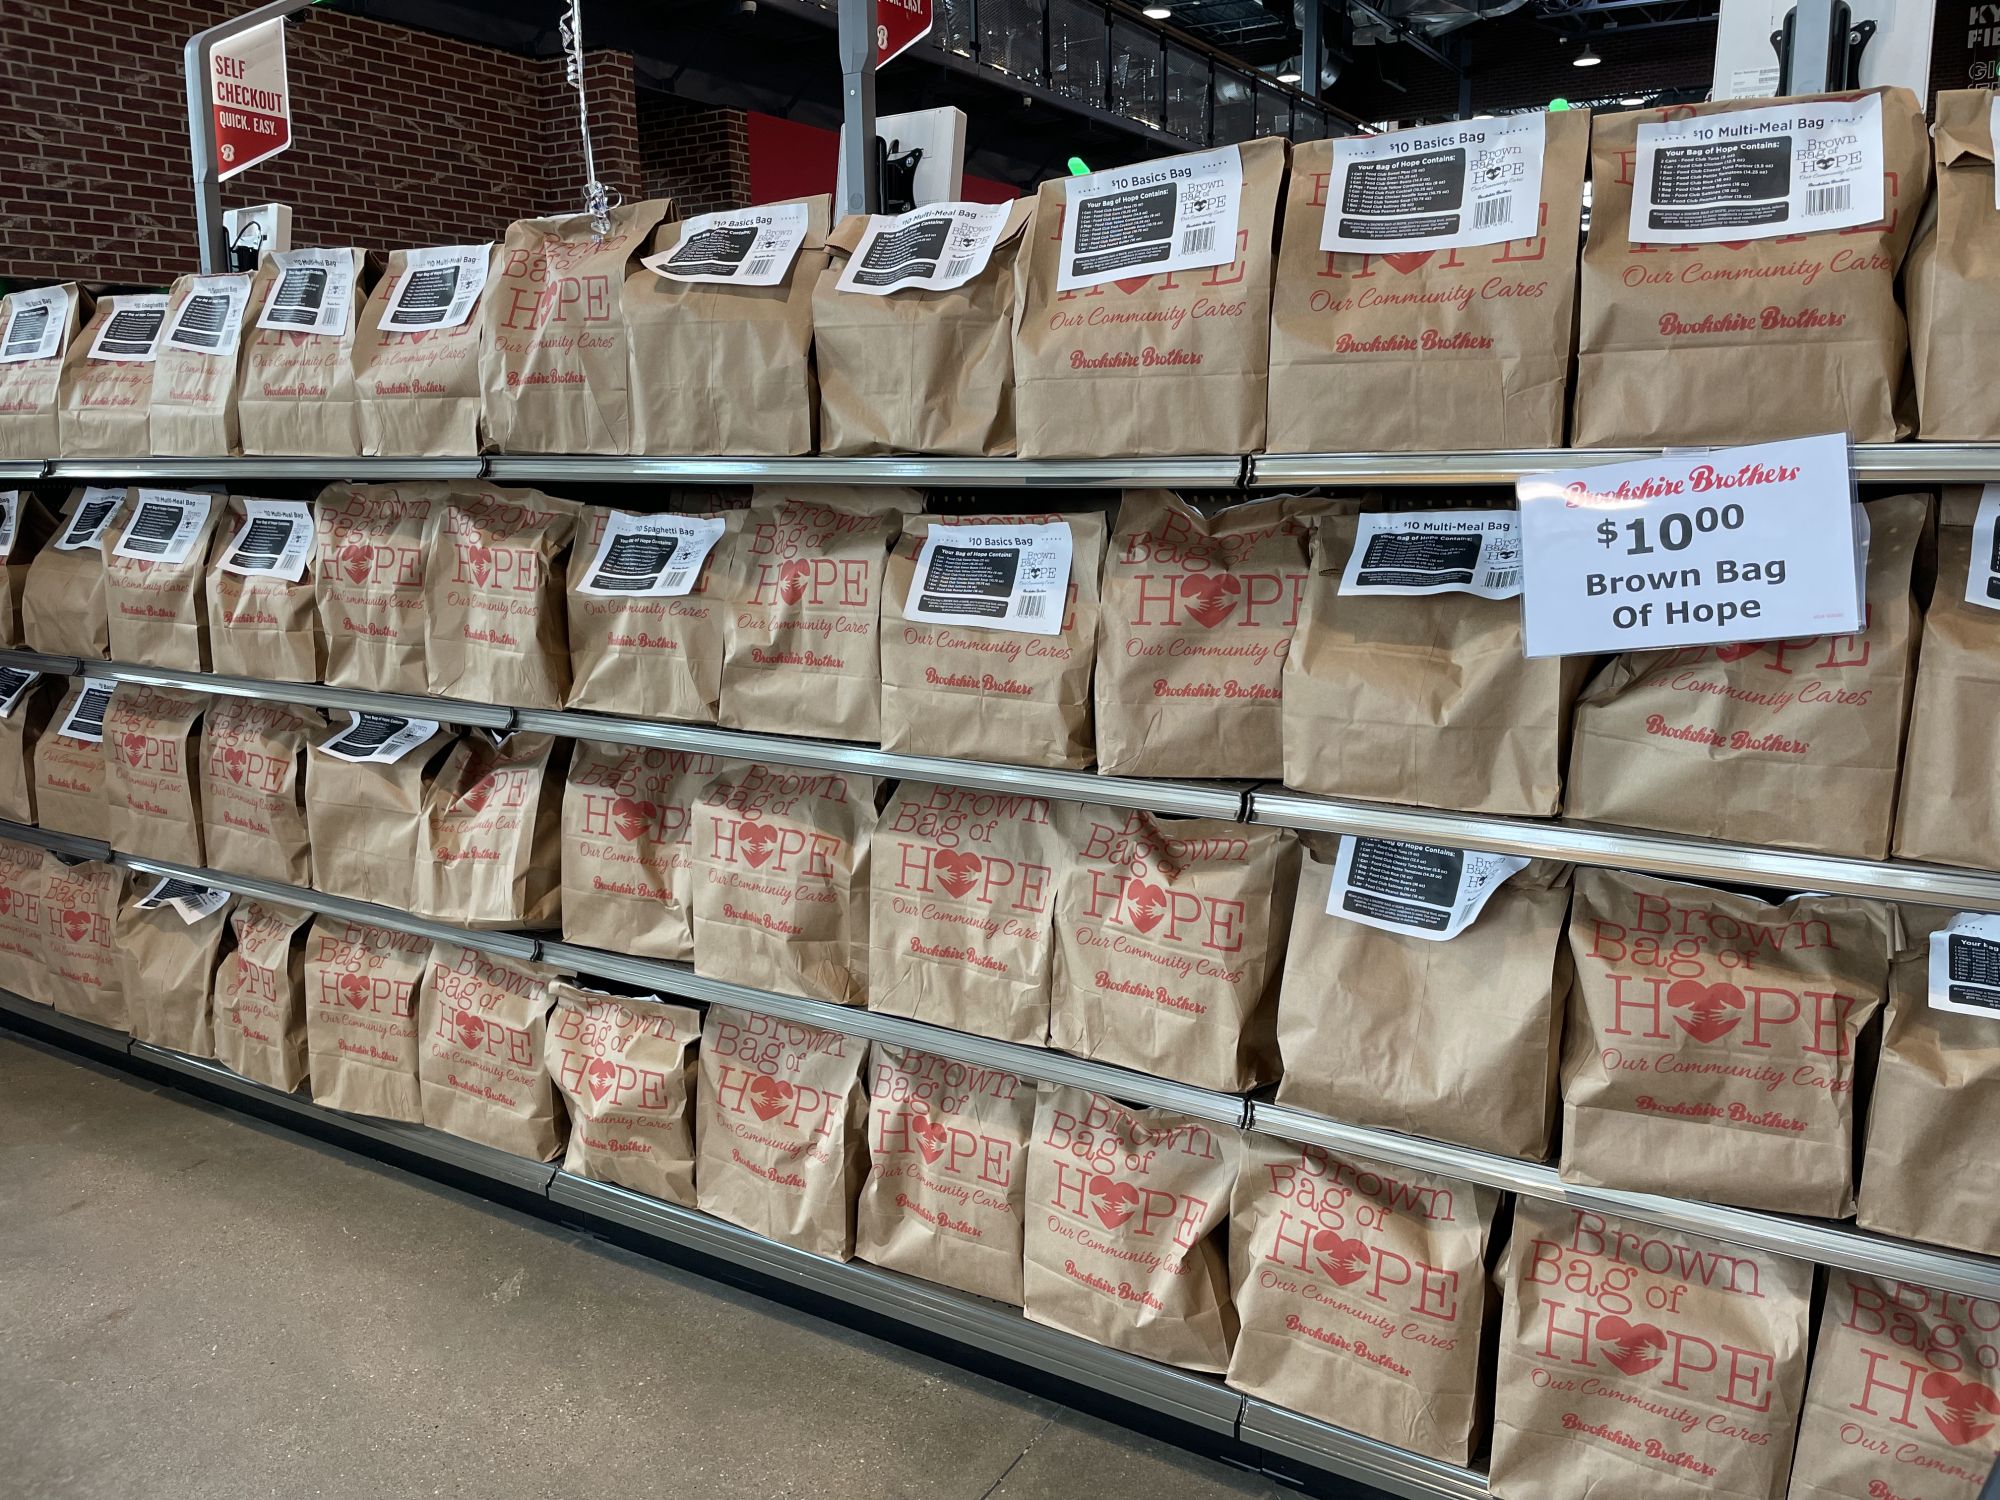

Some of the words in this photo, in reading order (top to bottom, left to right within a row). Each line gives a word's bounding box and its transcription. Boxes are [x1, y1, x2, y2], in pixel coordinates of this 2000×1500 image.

[215, 55, 245, 79] SELF
[217, 82, 282, 112] CHECKOUT
[220, 111, 250, 130] QUICK.
[254, 118, 277, 135] EASY.
[1694, 129, 1714, 141] $10
[1718, 119, 1792, 138] Multi-Meal
[1798, 118, 1824, 131] Bag
[1390, 142, 1409, 154] $10
[1414, 136, 1454, 151] Basics
[1459, 132, 1485, 143] Bag
[1479, 146, 1521, 160] Brown
[1666, 149, 1684, 157] Your
[1686, 147, 1702, 157] Bag
[1704, 146, 1714, 154] of
[1716, 143, 1739, 155] Hope
[1740, 141, 1780, 151] Contains:
[1112, 179, 1128, 190] $10
[1132, 173, 1166, 187] Basics
[1170, 167, 1192, 178] Bag
[1376, 162, 1390, 170] Bag
[1401, 158, 1420, 169] Hope
[1422, 154, 1456, 165] Contains:
[912, 209, 957, 223] Multi-Meal
[959, 209, 977, 219] Bag
[1102, 199, 1114, 207] Bag
[1122, 194, 1139, 204] Hope
[1140, 189, 1169, 200] Contains:
[729, 219, 754, 228] Basics
[755, 216, 772, 226] Bag
[1623, 264, 1674, 287] Our
[1681, 257, 1824, 286] Community
[1310, 290, 1354, 312] Our
[1357, 284, 1476, 311] Community
[1481, 277, 1548, 300] Cares
[1050, 311, 1084, 331] Our
[1087, 306, 1187, 330] Community
[1191, 298, 1247, 319] Cares
[1658, 312, 1756, 336] Brookshire
[1759, 305, 1847, 330] Brothers
[1070, 350, 1139, 369] Brookshire
[1142, 346, 1203, 367] Brothers
[1336, 333, 1417, 353] Brookshire
[1421, 329, 1494, 350] Brothers
[1565, 477, 1685, 508] Brookshire
[1688, 463, 1800, 493] Brothers
[643, 526, 677, 535] Spaghetti
[679, 527, 694, 536] Bag
[969, 537, 981, 545] $10
[985, 537, 1012, 546] Basics
[1015, 538, 1033, 546] Bag
[1404, 522, 1419, 530] $10
[1424, 522, 1484, 531] Multi-Meal
[1488, 522, 1510, 532] Bag
[1586, 566, 1701, 597] Brown
[1716, 559, 1786, 585] Bag
[1613, 604, 1652, 629] Of
[1666, 599, 1761, 627] Hope
[1671, 671, 1793, 714] Community
[1798, 682, 1873, 706] Cares
[1646, 714, 1726, 748] Brookshire
[1730, 730, 1809, 754] Brothers
[741, 764, 848, 804] Brown
[703, 784, 775, 821] Bag
[771, 797, 799, 816] of
[923, 784, 1051, 825] Brown
[889, 801, 967, 849] Bag
[968, 820, 998, 843] of
[708, 867, 729, 886] Our
[730, 873, 792, 905] Community
[795, 885, 838, 904] Cares
[723, 903, 762, 926] Brookshire
[762, 913, 803, 935] Brothers
[892, 896, 919, 917] Our
[921, 903, 1001, 940] Community
[1629, 891, 1840, 951] Brown
[910, 936, 965, 960] Brookshire
[966, 947, 1008, 972] Brothers
[1585, 917, 1709, 978] Bag
[1717, 948, 1760, 970] of
[1601, 1047, 1649, 1071] Our
[1654, 1053, 1786, 1091] Community
[1079, 1093, 1215, 1159] Brown
[1635, 1095, 1724, 1118] Brookshire
[1727, 1102, 1807, 1131] Brothers
[1043, 1109, 1125, 1176] Bag
[1125, 1151, 1155, 1174] of
[1264, 1163, 1352, 1230] Bag
[1356, 1205, 1392, 1232] of
[1297, 1144, 1455, 1222] Brown
[1047, 1215, 1075, 1239] Our
[1077, 1229, 1161, 1274] Community
[1565, 1209, 1765, 1299] Brown
[1065, 1259, 1116, 1295] Brookshire
[1524, 1239, 1638, 1315] Bag
[1646, 1285, 1688, 1314] of
[1260, 1270, 1297, 1293] Our
[1302, 1284, 1397, 1339] Community
[1401, 1323, 1459, 1351] Cares
[1285, 1314, 1351, 1351] Brookshire
[1354, 1340, 1412, 1377] Brothers
[1530, 1368, 1576, 1392] Our
[1581, 1378, 1701, 1433] Community
[1705, 1414, 1772, 1446] Cares
[1561, 1412, 1641, 1452] Brookshire
[1645, 1438, 1717, 1477] Brothers
